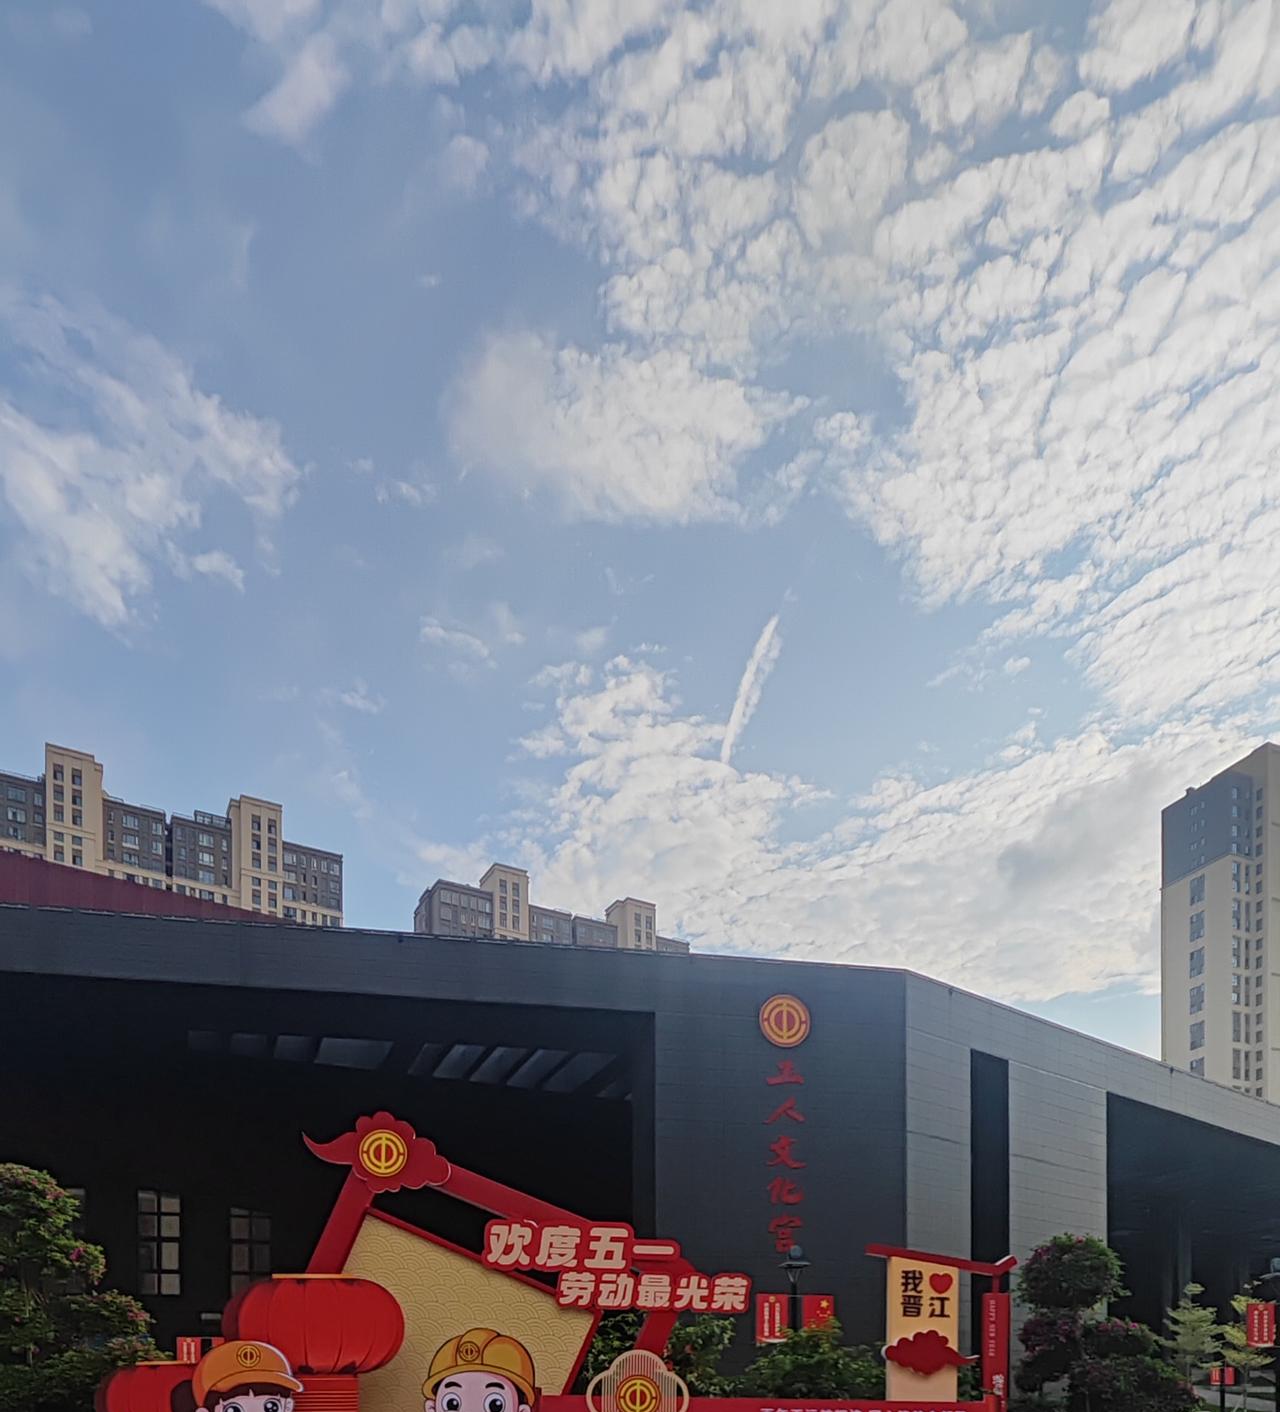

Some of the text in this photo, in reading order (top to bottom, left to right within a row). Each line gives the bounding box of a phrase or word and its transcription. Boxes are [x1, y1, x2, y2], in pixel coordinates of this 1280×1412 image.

[764, 1059, 806, 1254] 工人文化宫
[486, 1224, 675, 1270] 欢度五一
[558, 1272, 749, 1311] 劳动最光荣
[901, 1269, 924, 1294] 我
[901, 1295, 951, 1318] 晋江
